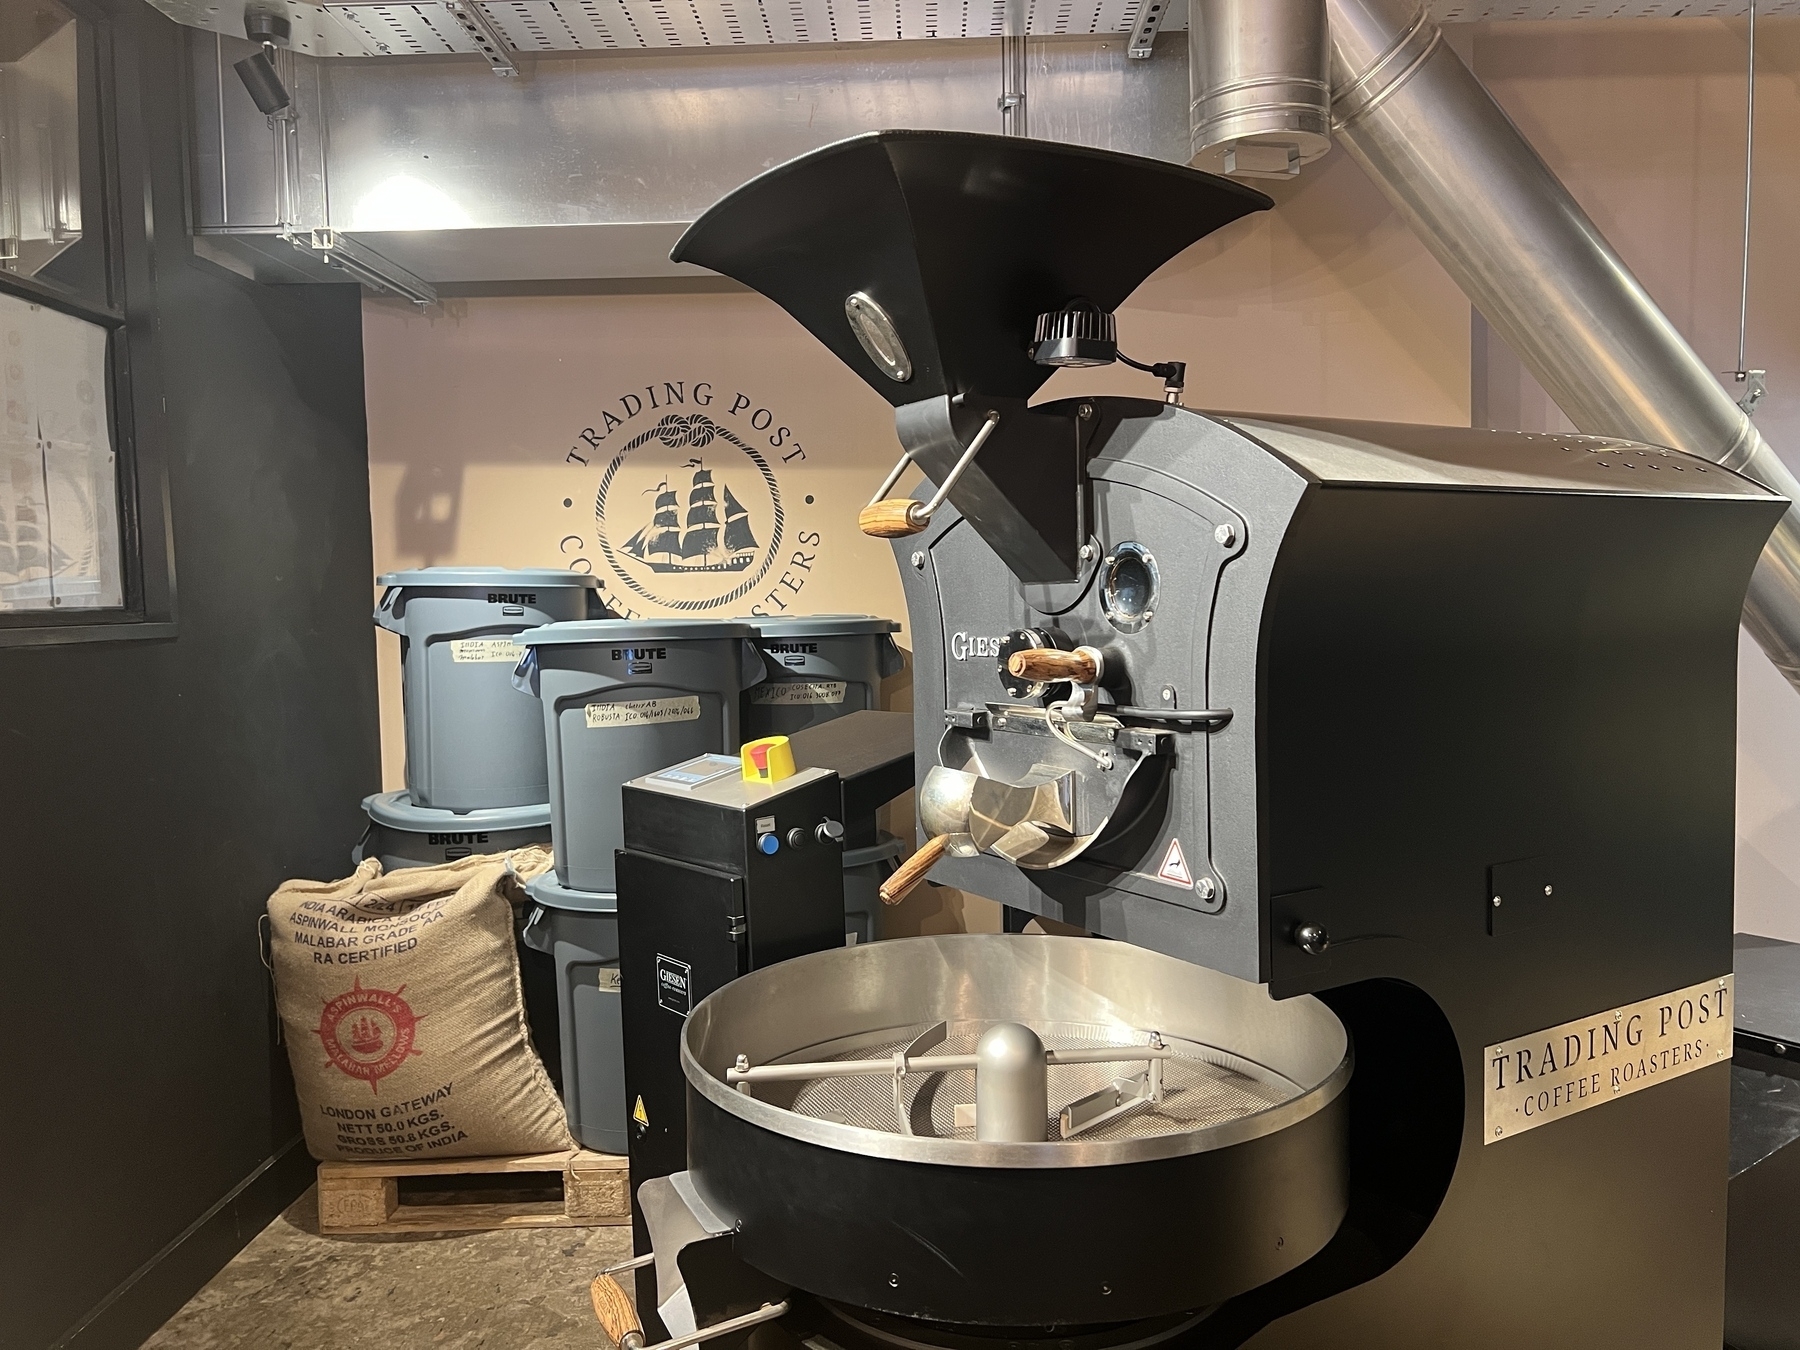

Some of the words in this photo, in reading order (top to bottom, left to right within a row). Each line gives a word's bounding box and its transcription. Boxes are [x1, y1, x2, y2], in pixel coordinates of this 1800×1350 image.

[565, 381, 714, 468] TRADING
[728, 392, 806, 464] POST
[487, 593, 537, 604] BRUTE
[611, 647, 667, 660] BRUTE
[770, 643, 817, 653] BRUTE
[951, 631, 1000, 662] GIES
[428, 832, 489, 845] BRUTE
[290, 911, 357, 933] ASPINWALL
[294, 931, 358, 948] MALABAR
[362, 923, 418, 945] GRADE
[422, 911, 443, 928] AA
[313, 951, 334, 965] RA
[338, 937, 418, 964] CERTIFIED
[1491, 1013, 1643, 1091] TRADING
[1658, 988, 1728, 1038] POST
[1522, 1073, 1601, 1117] COFFEE
[1610, 1039, 1703, 1087] ROASTERS
[319, 1104, 377, 1120] LONDON
[380, 1082, 453, 1118] GATEWAY
[336, 1122, 373, 1135] NETT
[376, 1120, 405, 1134] 50.0
[407, 1109, 444, 1129] KGS.
[336, 1134, 387, 1146] GROSS
[388, 1133, 416, 1145] 50.8
[417, 1121, 456, 1140] KGS.
[335, 1144, 403, 1155] PRODUCE
[405, 1143, 425, 1153] OF
[427, 1130, 468, 1149] INDIA
